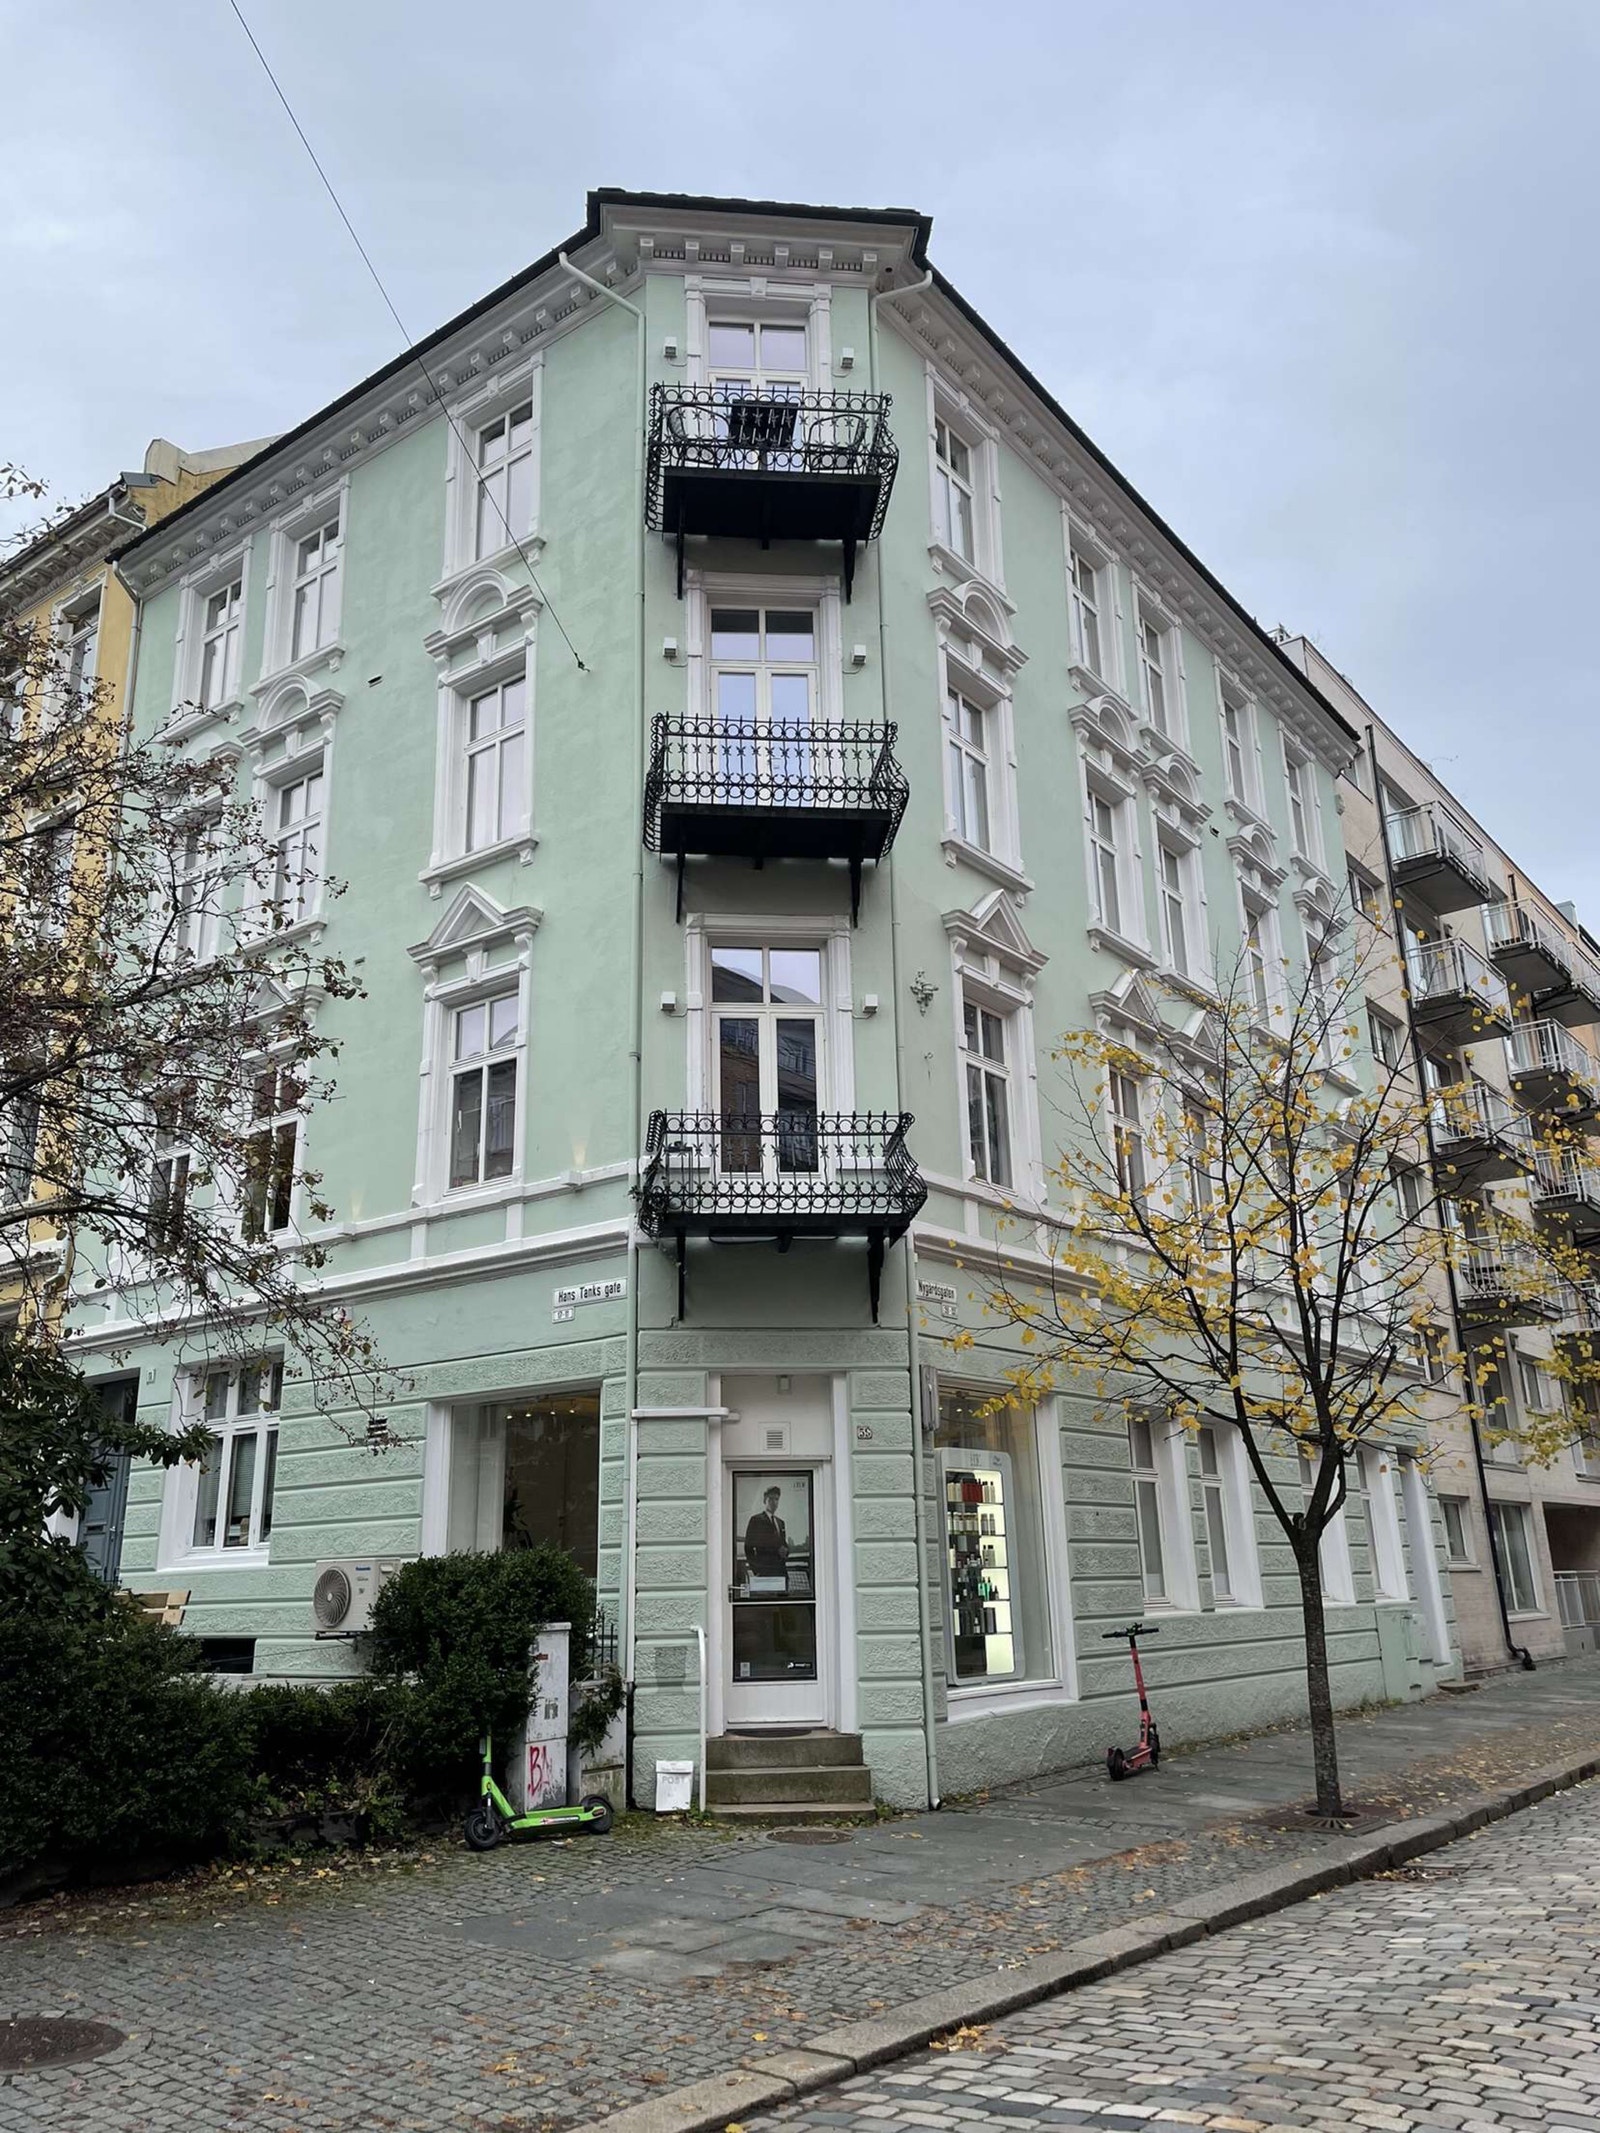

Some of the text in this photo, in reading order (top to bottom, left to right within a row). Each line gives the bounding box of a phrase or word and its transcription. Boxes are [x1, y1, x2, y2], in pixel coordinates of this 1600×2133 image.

[558, 1282, 621, 1303] Hans Tanks gate
[662, 1776, 686, 1785] POST
